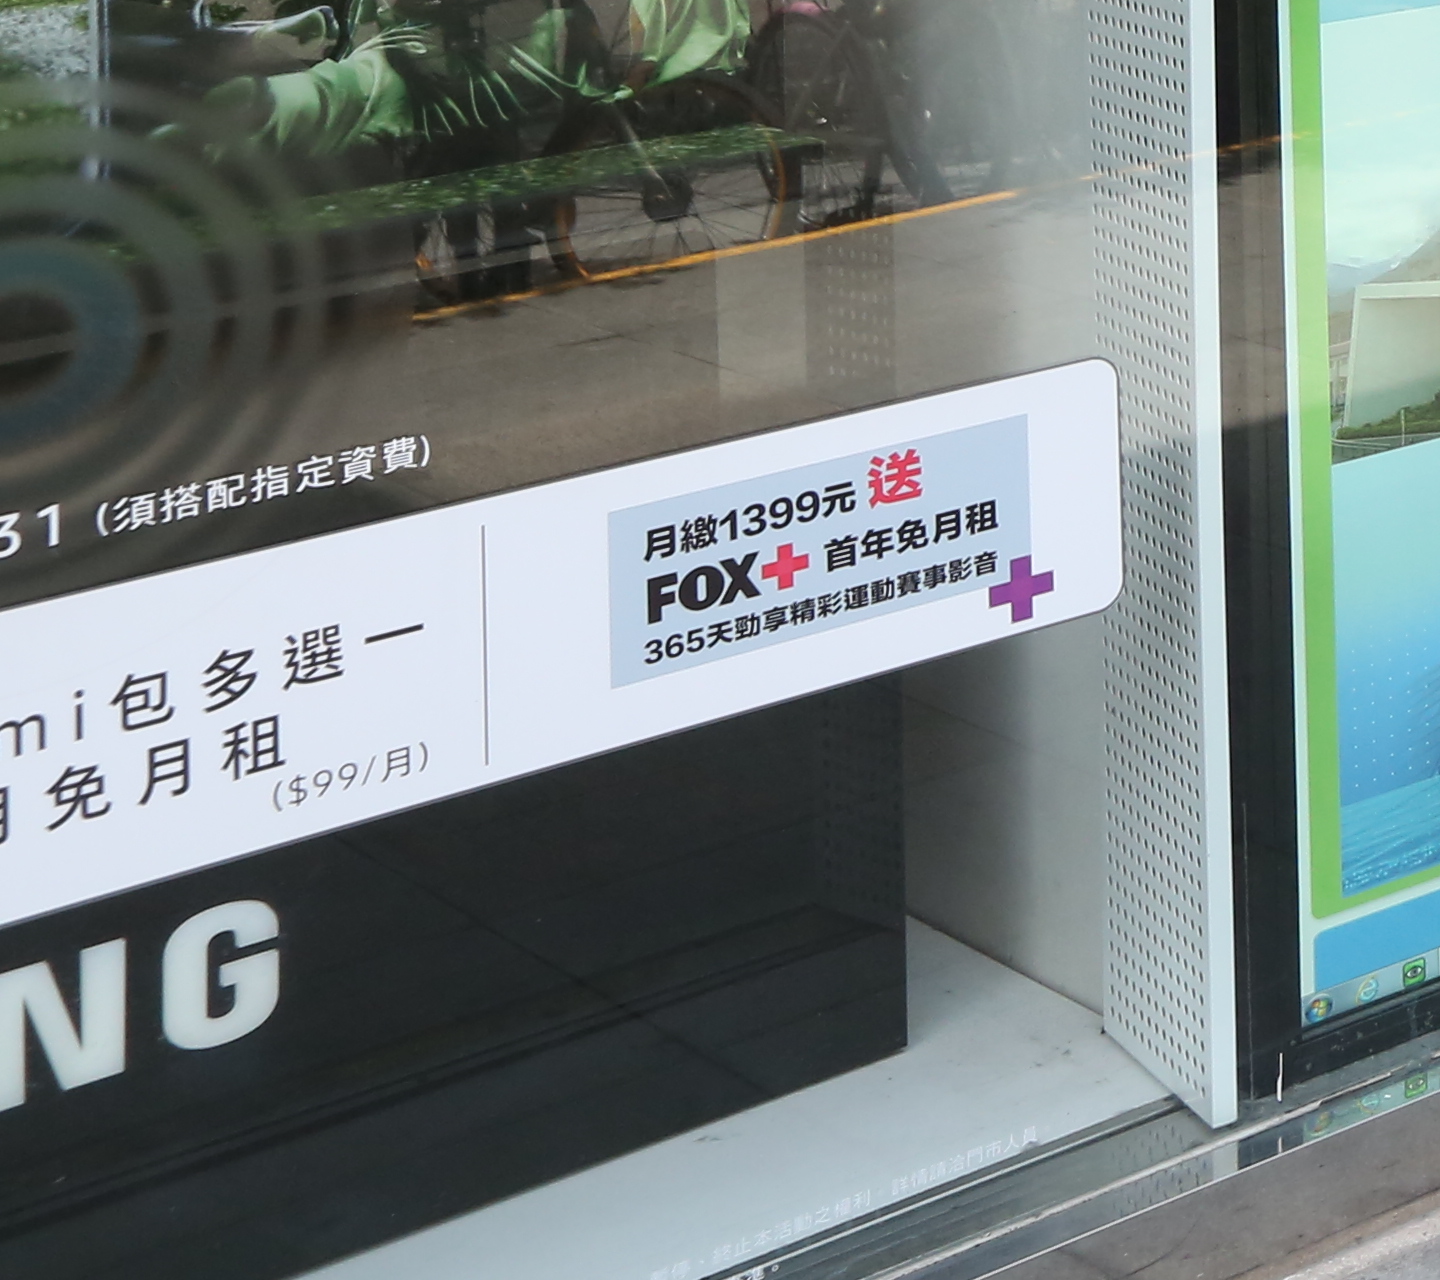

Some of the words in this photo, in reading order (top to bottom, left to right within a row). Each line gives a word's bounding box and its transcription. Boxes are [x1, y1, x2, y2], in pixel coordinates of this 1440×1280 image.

[95, 434, 432, 538] (須搭配指定資費)
[643, 480, 858, 564] 月繳1399元
[867, 448, 925, 510] 送
[824, 498, 1000, 573] 首年免月租
[643, 550, 999, 666] 365天勁享精彩運動賽事影音
[271, 741, 430, 813] ($99/月)
